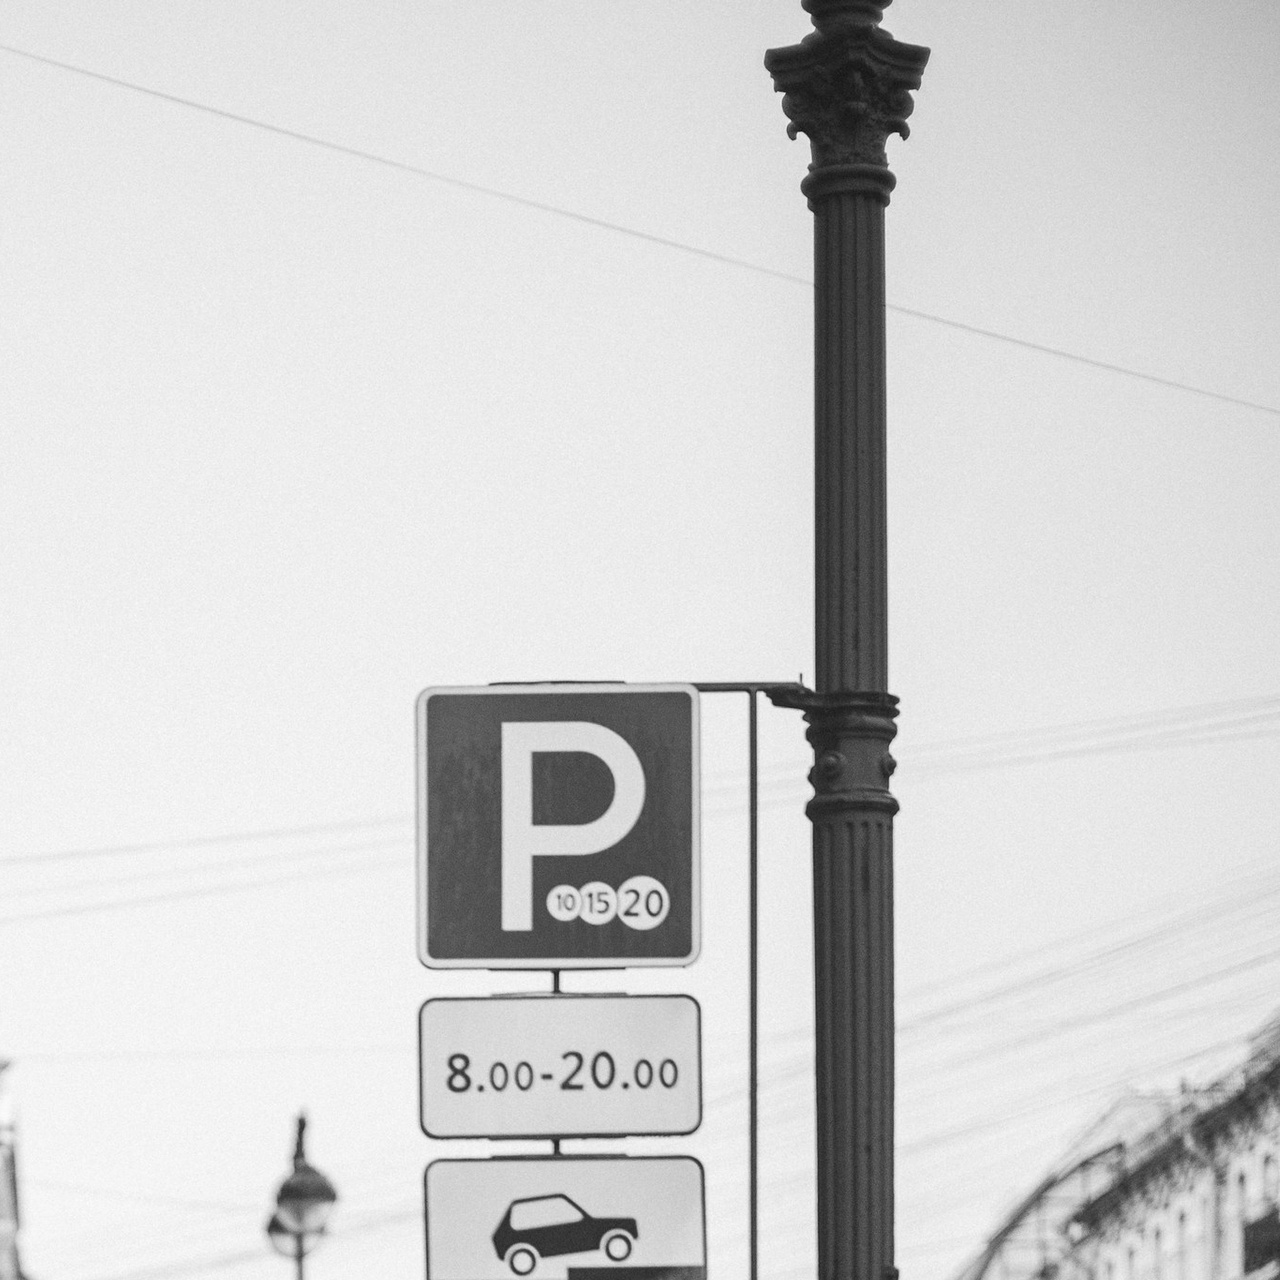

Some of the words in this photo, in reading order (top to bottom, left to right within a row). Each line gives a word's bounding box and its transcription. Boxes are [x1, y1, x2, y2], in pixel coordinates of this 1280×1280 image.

[500, 721, 646, 931] P
[556, 893, 577, 912] 10
[587, 892, 611, 915] 15
[622, 888, 664, 917] 20
[445, 1049, 679, 1094] 8.00-20.00
